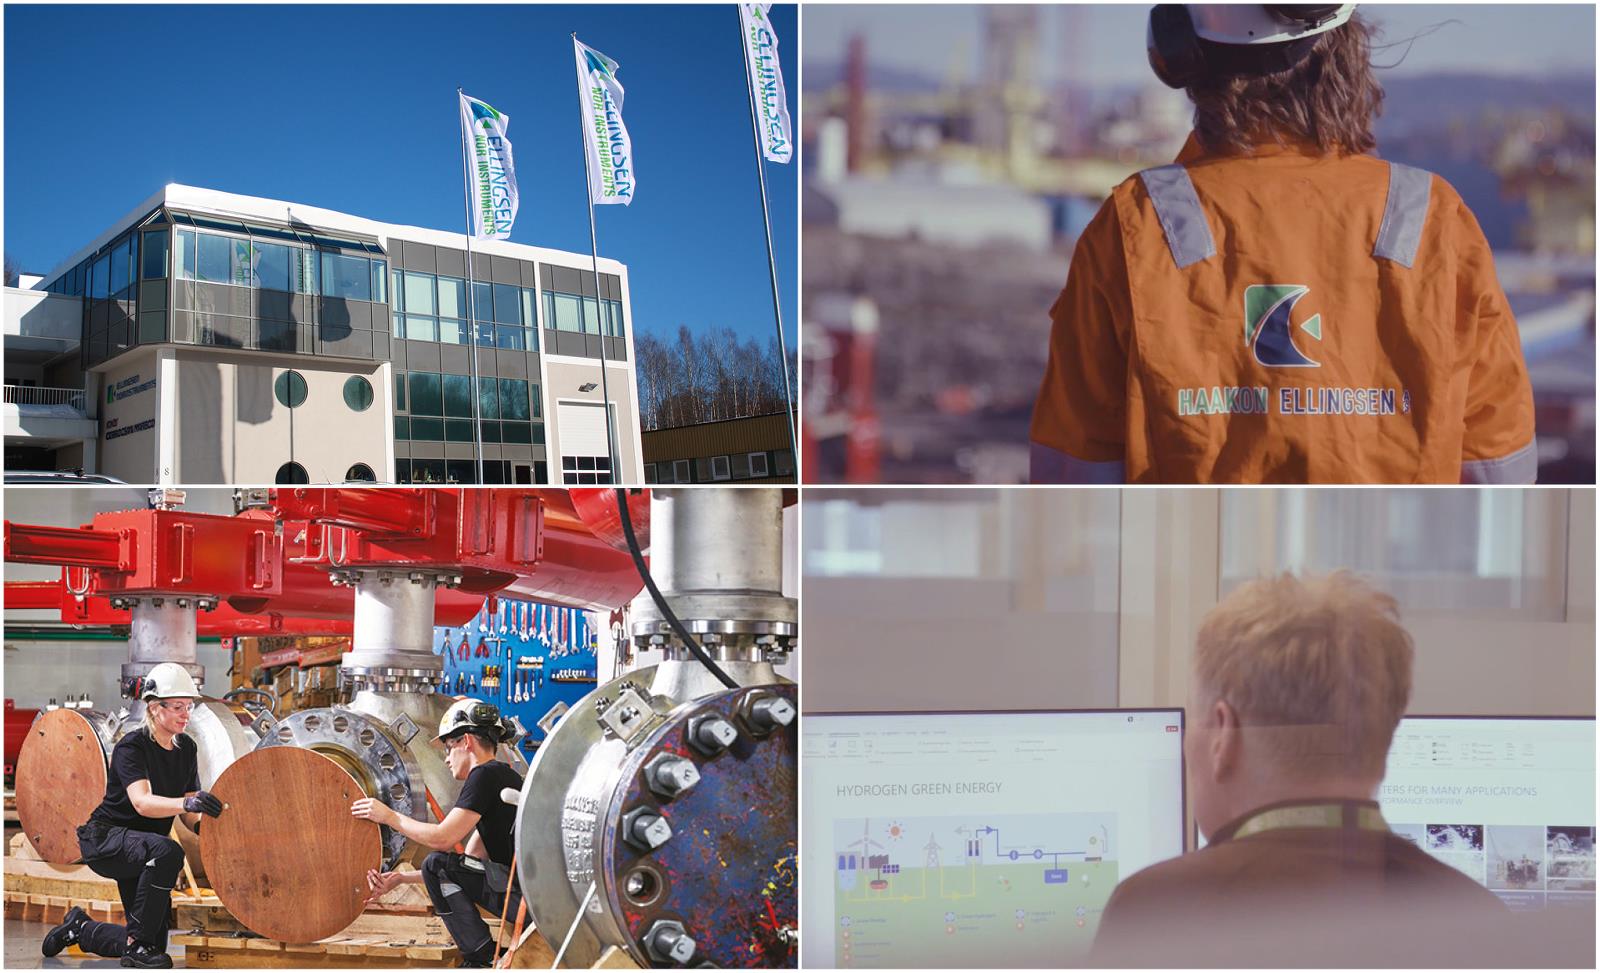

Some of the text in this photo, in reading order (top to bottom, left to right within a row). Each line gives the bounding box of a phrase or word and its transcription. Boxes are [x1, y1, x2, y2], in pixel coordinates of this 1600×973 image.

[591, 86, 616, 197] NOR INSTRUMENTS
[475, 134, 496, 235] NOR INSTRUMENTS
[486, 136, 513, 234] ELLINGSEN
[1179, 387, 1268, 415] HAAKON
[1280, 388, 1395, 415] ELLINGSEN
[837, 781, 1002, 797] HYDROGEN GREEN ENERGY
[1408, 785, 1428, 795] FOR
[1431, 785, 1462, 796] MANY
[1465, 786, 1537, 797] APPLICATIONS
